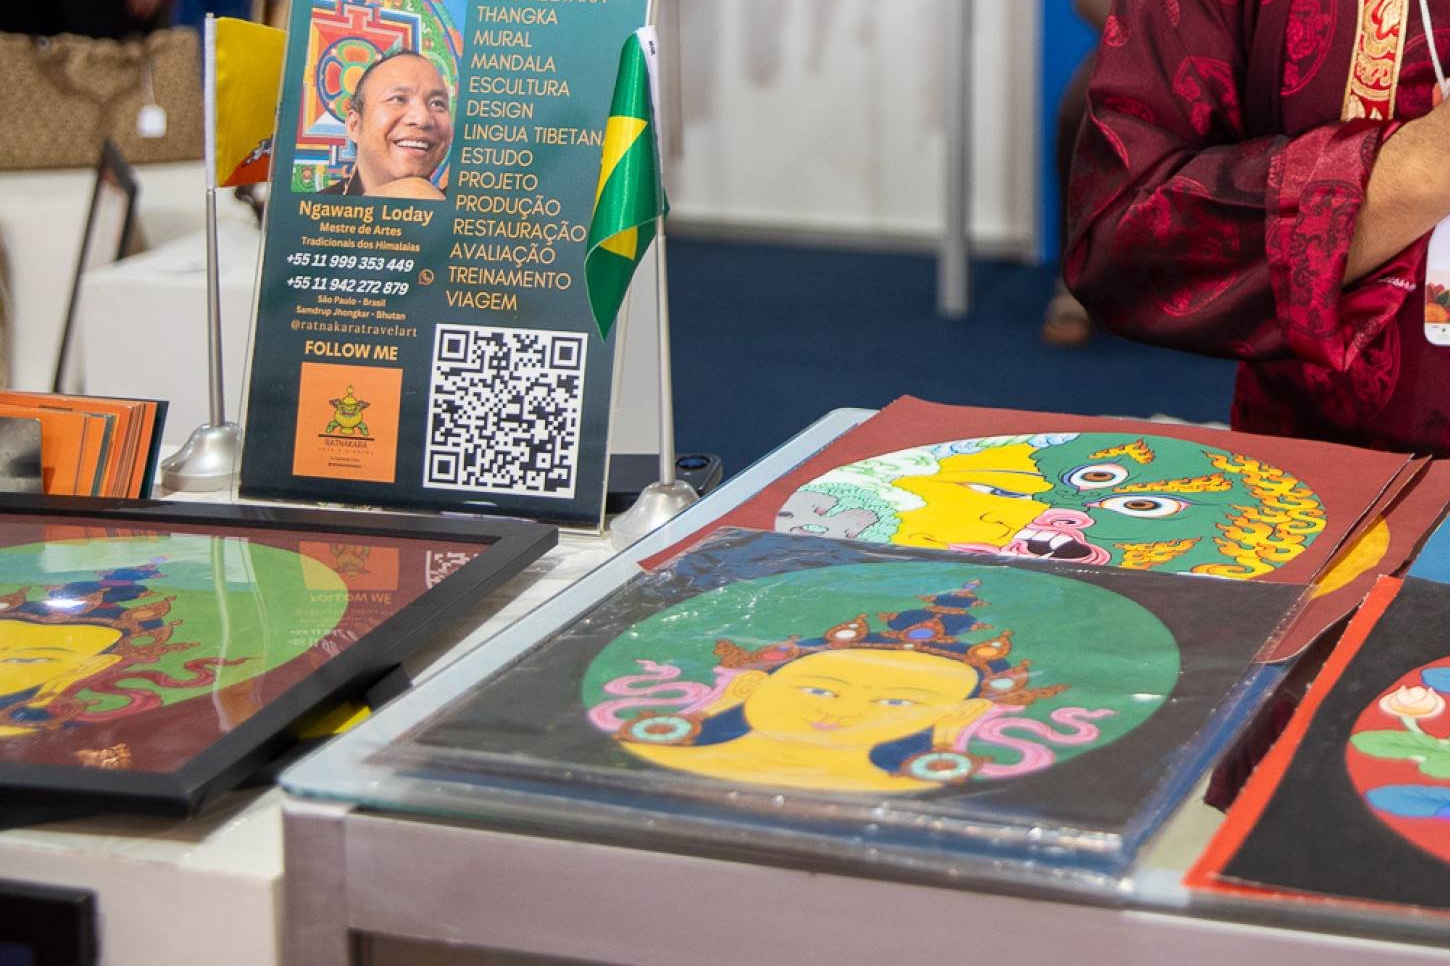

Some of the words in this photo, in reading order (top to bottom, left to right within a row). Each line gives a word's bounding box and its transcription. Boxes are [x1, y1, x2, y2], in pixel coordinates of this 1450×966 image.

[477, 6, 558, 25] THANGKA
[473, 30, 533, 47] MURAL
[470, 53, 556, 72] MANDALA
[468, 76, 570, 96] ESCULTURA
[466, 100, 534, 118] DESIGN
[463, 124, 528, 143] LINGUA
[461, 147, 533, 167] ESTUDO
[458, 171, 538, 191] PROJETO
[299, 200, 374, 223] Ngawang
[381, 204, 433, 227] Loday
[455, 194, 561, 219] PRODUÇÃO
[319, 222, 355, 234] Mestre
[357, 224, 370, 235] de
[373, 225, 402, 237] Artes
[453, 218, 587, 245] RESTAURAÇÃO
[302, 236, 355, 248] Tradicionais
[357, 239, 373, 249] dos
[375, 240, 421, 252] Himalaias
[286, 252, 311, 267] +55
[311, 253, 327, 267] 11
[329, 255, 357, 269] 999
[358, 257, 385, 270] 353
[386, 259, 414, 273] 449
[450, 242, 556, 267] AVALIAÇÃO
[287, 276, 311, 290] +55
[312, 277, 327, 290] 11
[330, 278, 356, 293] 942
[356, 280, 382, 294] 272
[383, 282, 409, 296] 879
[448, 265, 572, 290] TREINAMENTO
[318, 294, 332, 304] São
[334, 296, 356, 305] Paulo
[363, 298, 386, 307] Brasil
[446, 290, 517, 311] VIAGEM
[296, 306, 331, 317] Samdrup
[376, 311, 406, 321] Bhutan
[291, 319, 417, 338] @ratnakaratravelart
[304, 340, 371, 359] FOLLOW
[374, 345, 398, 361] ME
[324, 439, 368, 449] RATNAKARA
